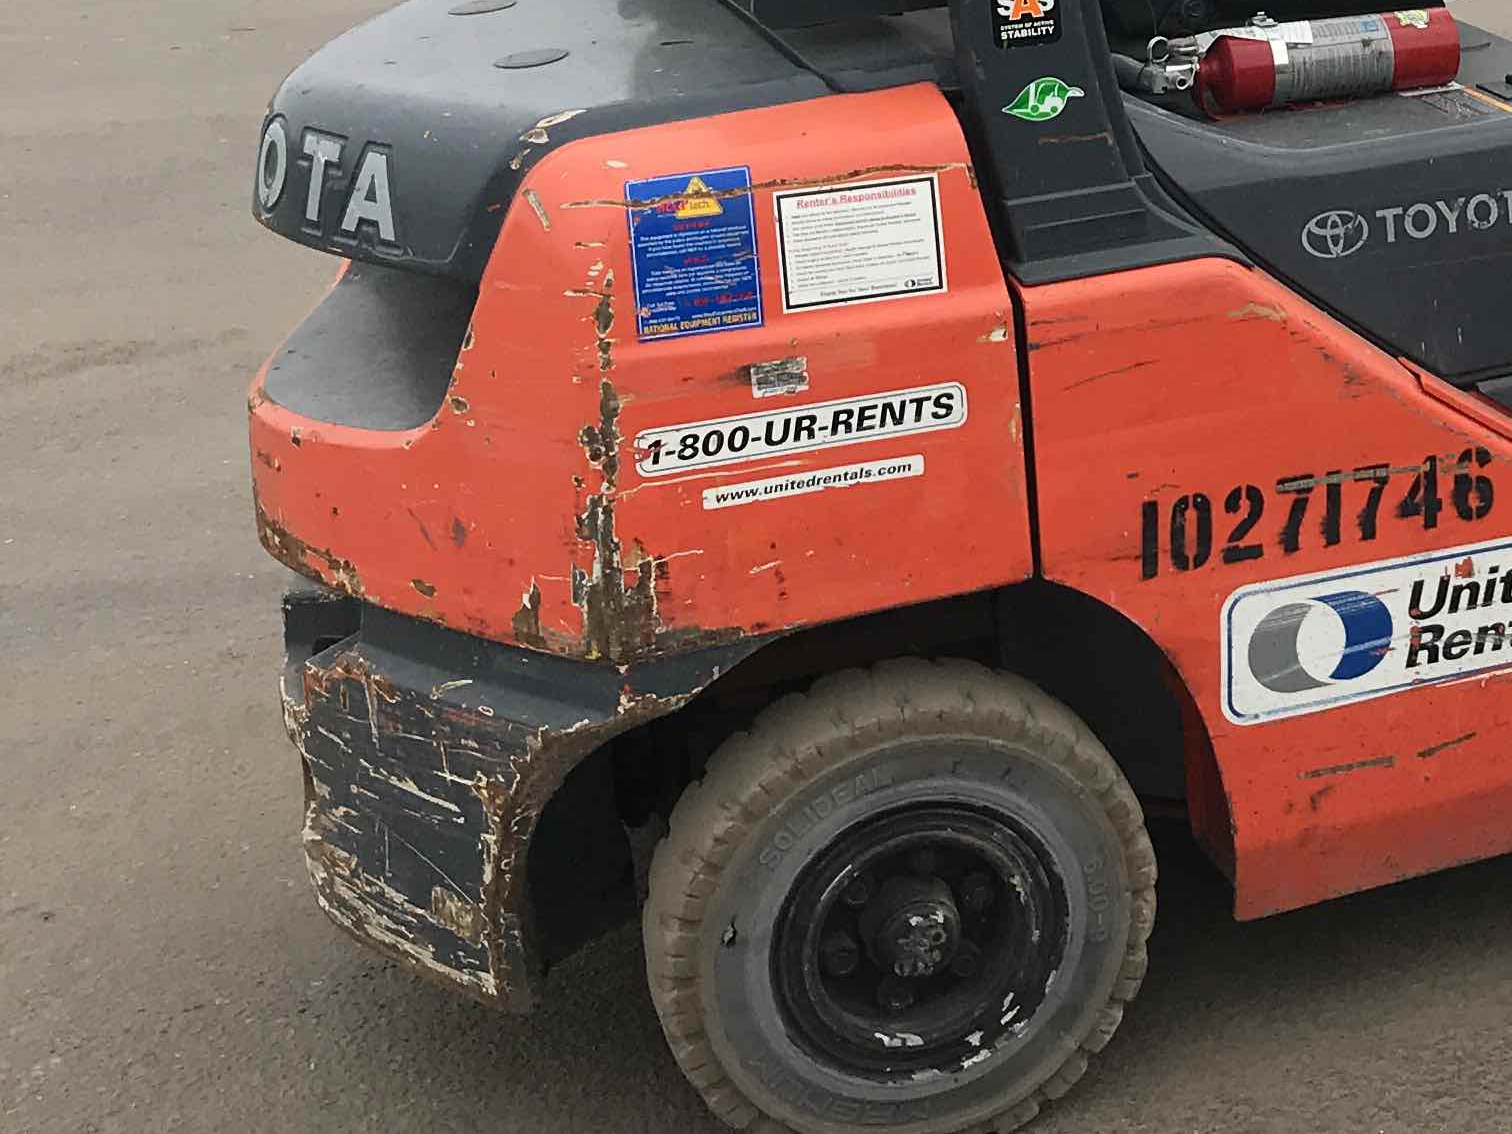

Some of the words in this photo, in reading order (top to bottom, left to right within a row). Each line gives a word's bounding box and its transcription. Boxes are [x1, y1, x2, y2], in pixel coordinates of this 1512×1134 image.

[1001, 25, 1055, 40] STABILITY
[796, 196, 837, 209] Renter's
[839, 187, 917, 203] Responsibilities
[648, 392, 954, 466] 1-800-UR-RENTS
[715, 462, 912, 504] www.unitedrentals.com
[1141, 446, 1494, 581] 10271746
